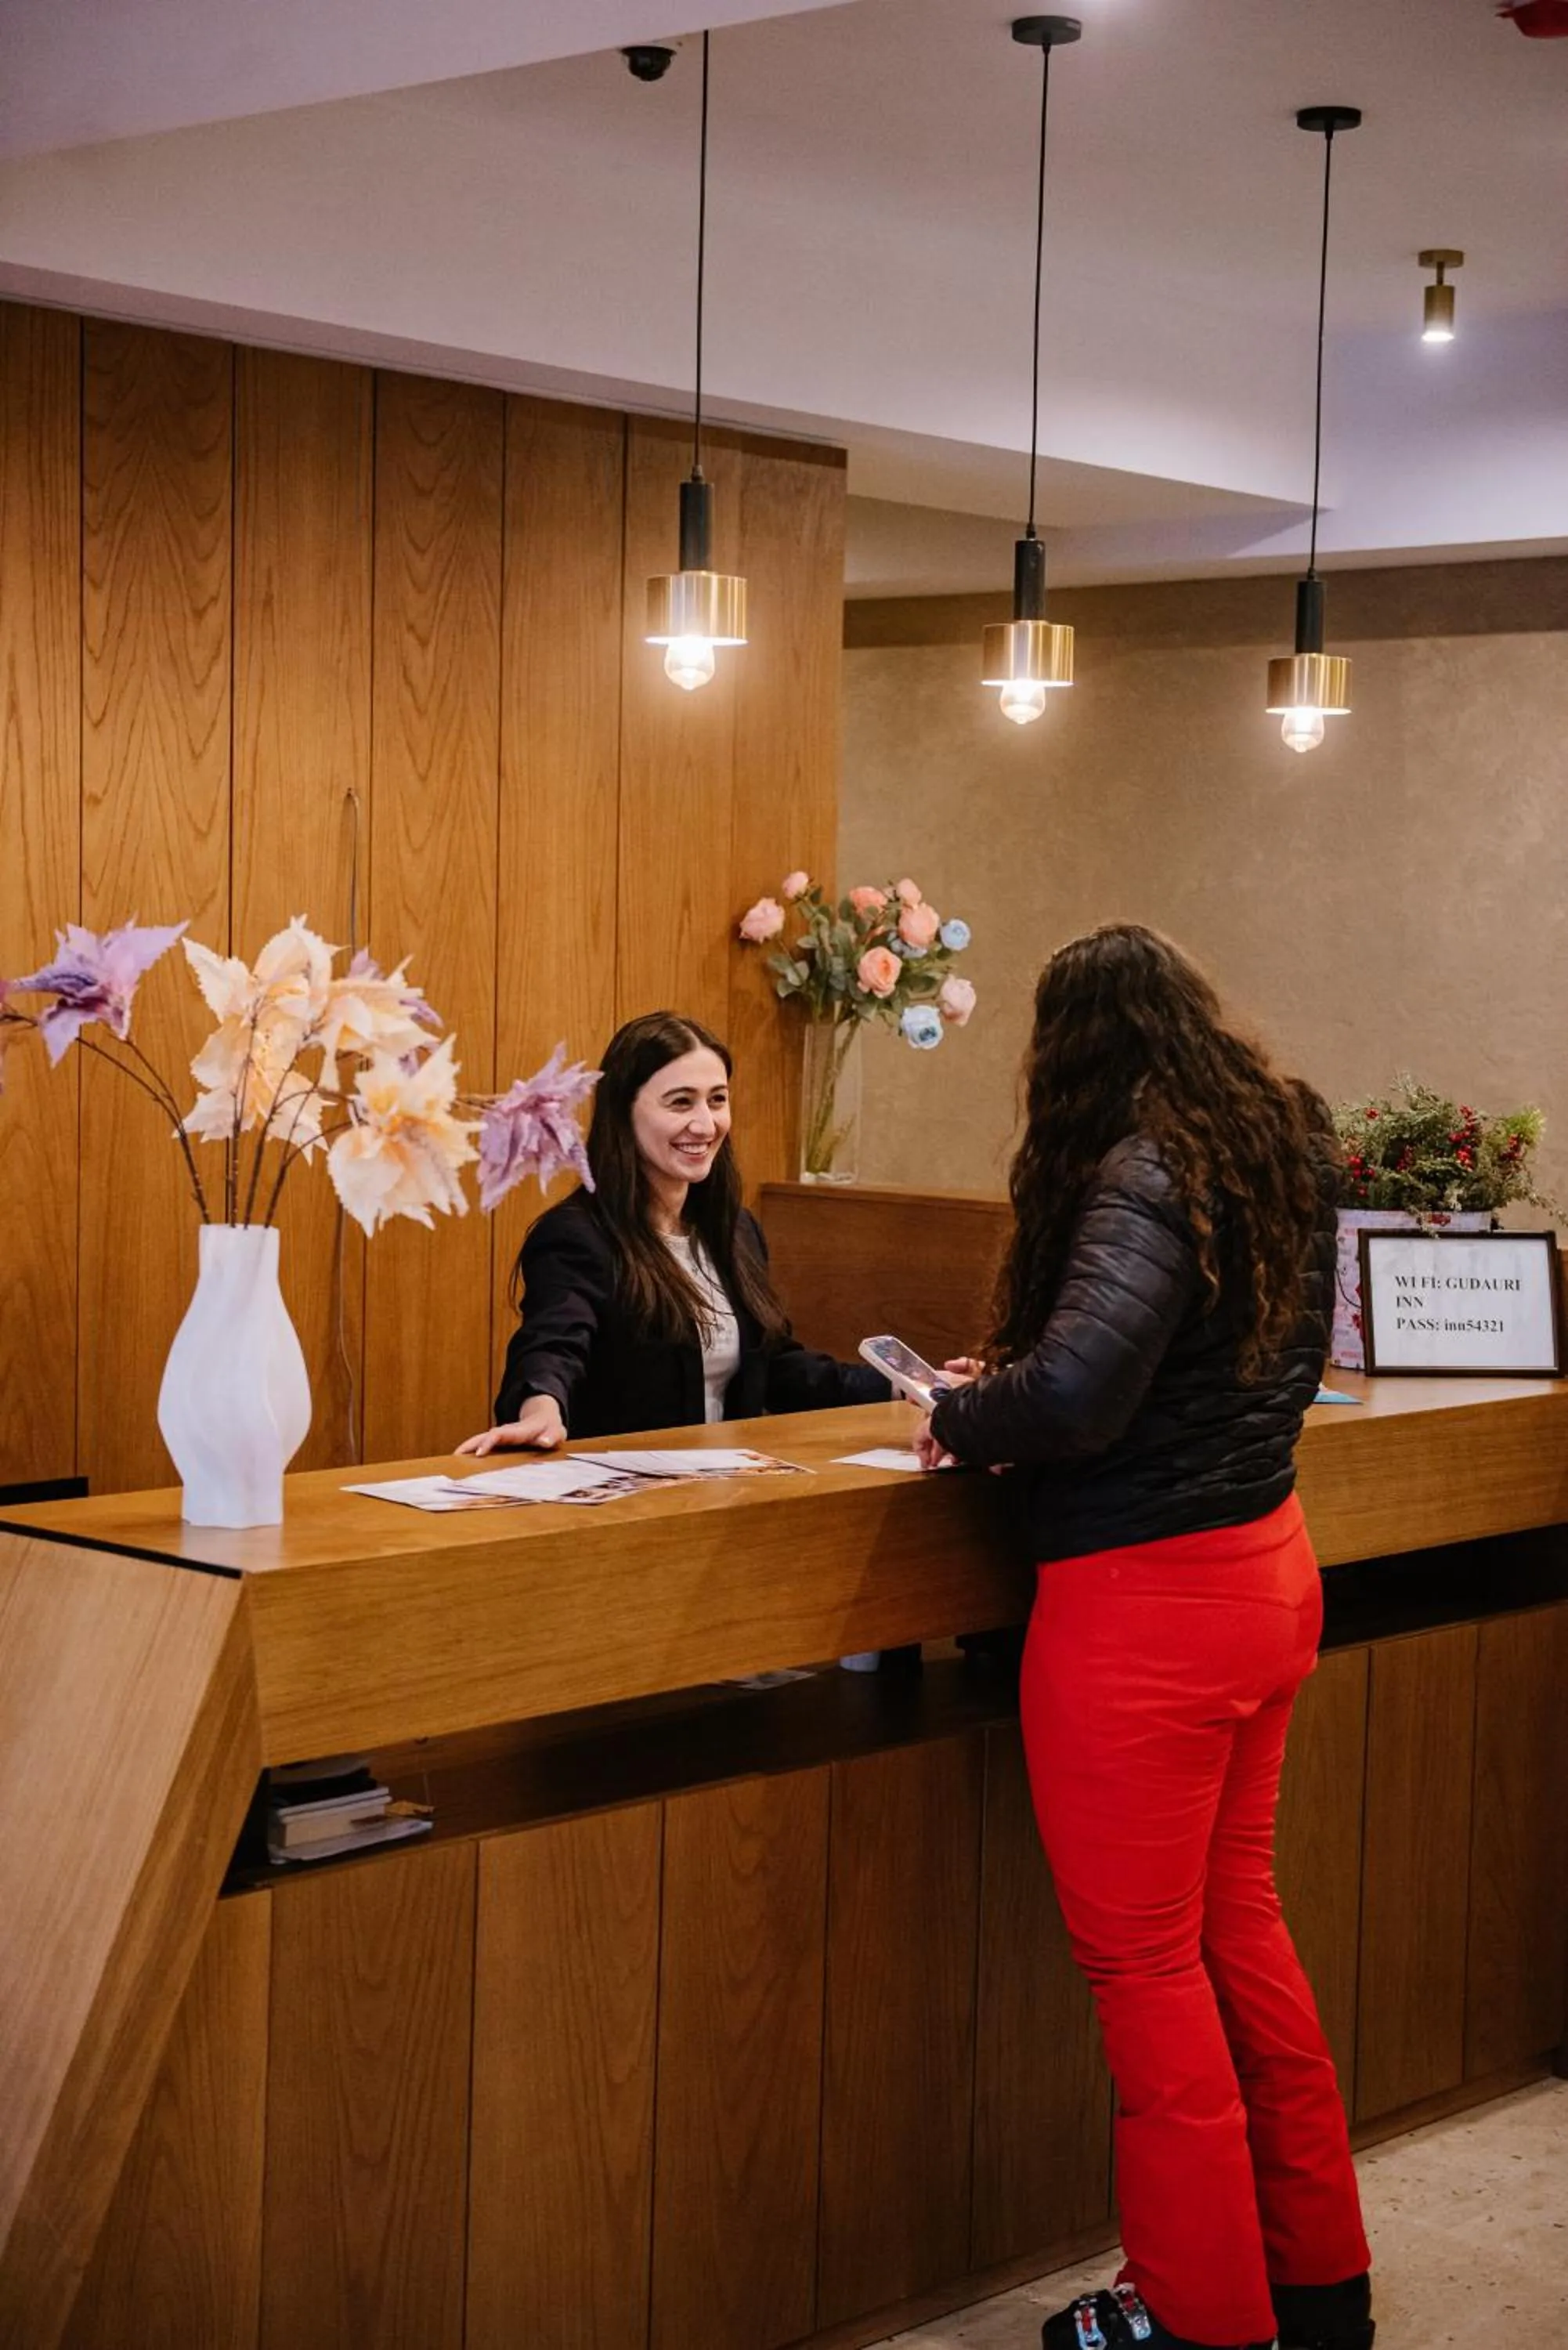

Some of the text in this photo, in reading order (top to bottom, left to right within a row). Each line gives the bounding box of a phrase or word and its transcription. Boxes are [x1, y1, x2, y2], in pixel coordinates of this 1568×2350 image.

[1445, 1277, 1522, 1291] GUDAURI
[1396, 1296, 1424, 1307] INN
[1396, 1318, 1504, 1332] PASS: inn54321
